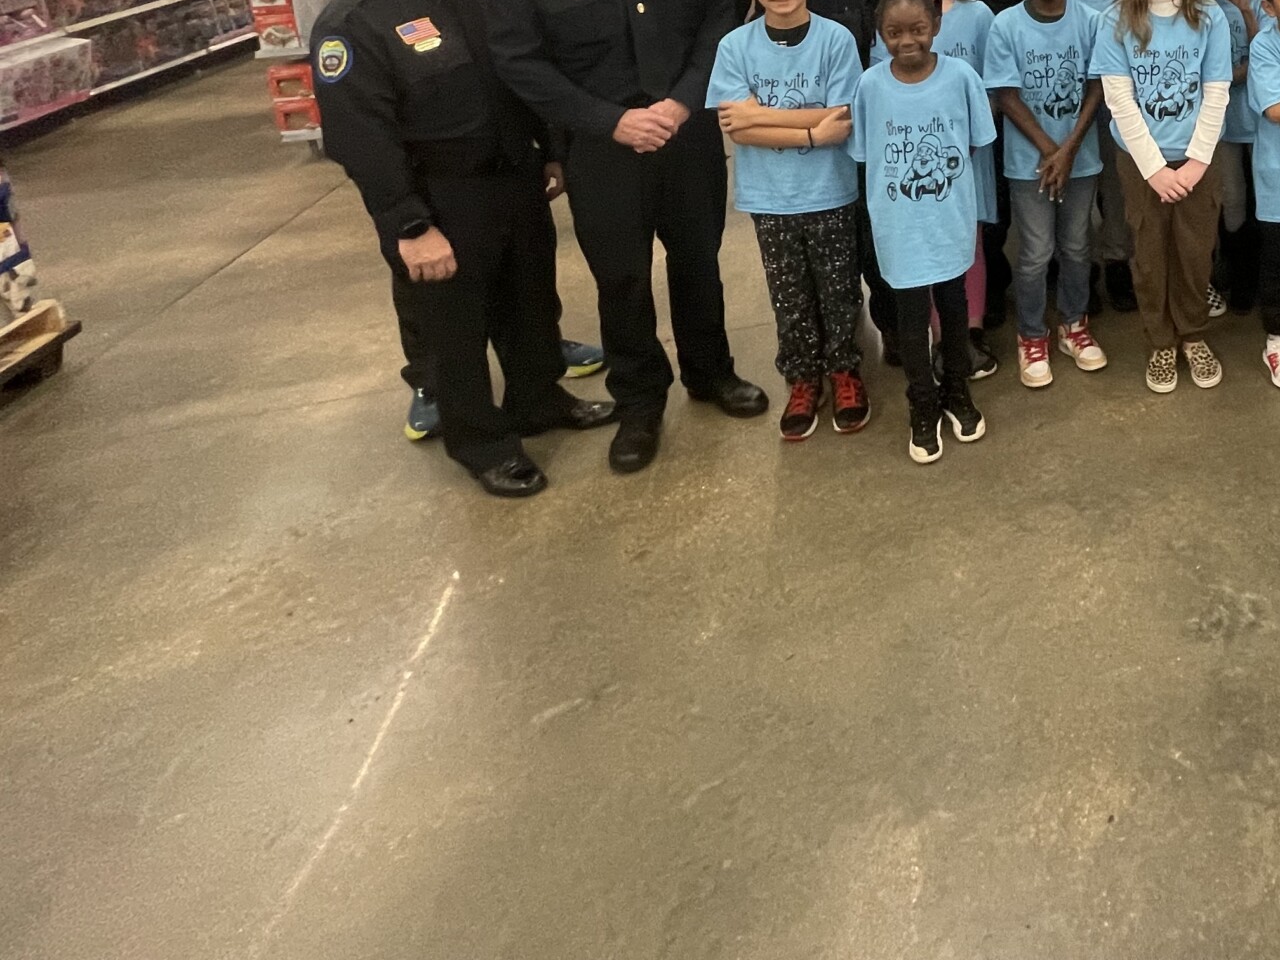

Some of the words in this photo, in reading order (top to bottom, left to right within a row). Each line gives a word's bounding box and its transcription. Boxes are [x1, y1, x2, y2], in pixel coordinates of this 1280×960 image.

[943, 42, 968, 58] with
[1025, 49, 1053, 67] Shop
[1056, 44, 1080, 60] with
[1164, 44, 1189, 60] with
[1193, 47, 1199, 58] a
[784, 72, 809, 89] with
[885, 119, 913, 141] Shop
[917, 116, 945, 133] with
